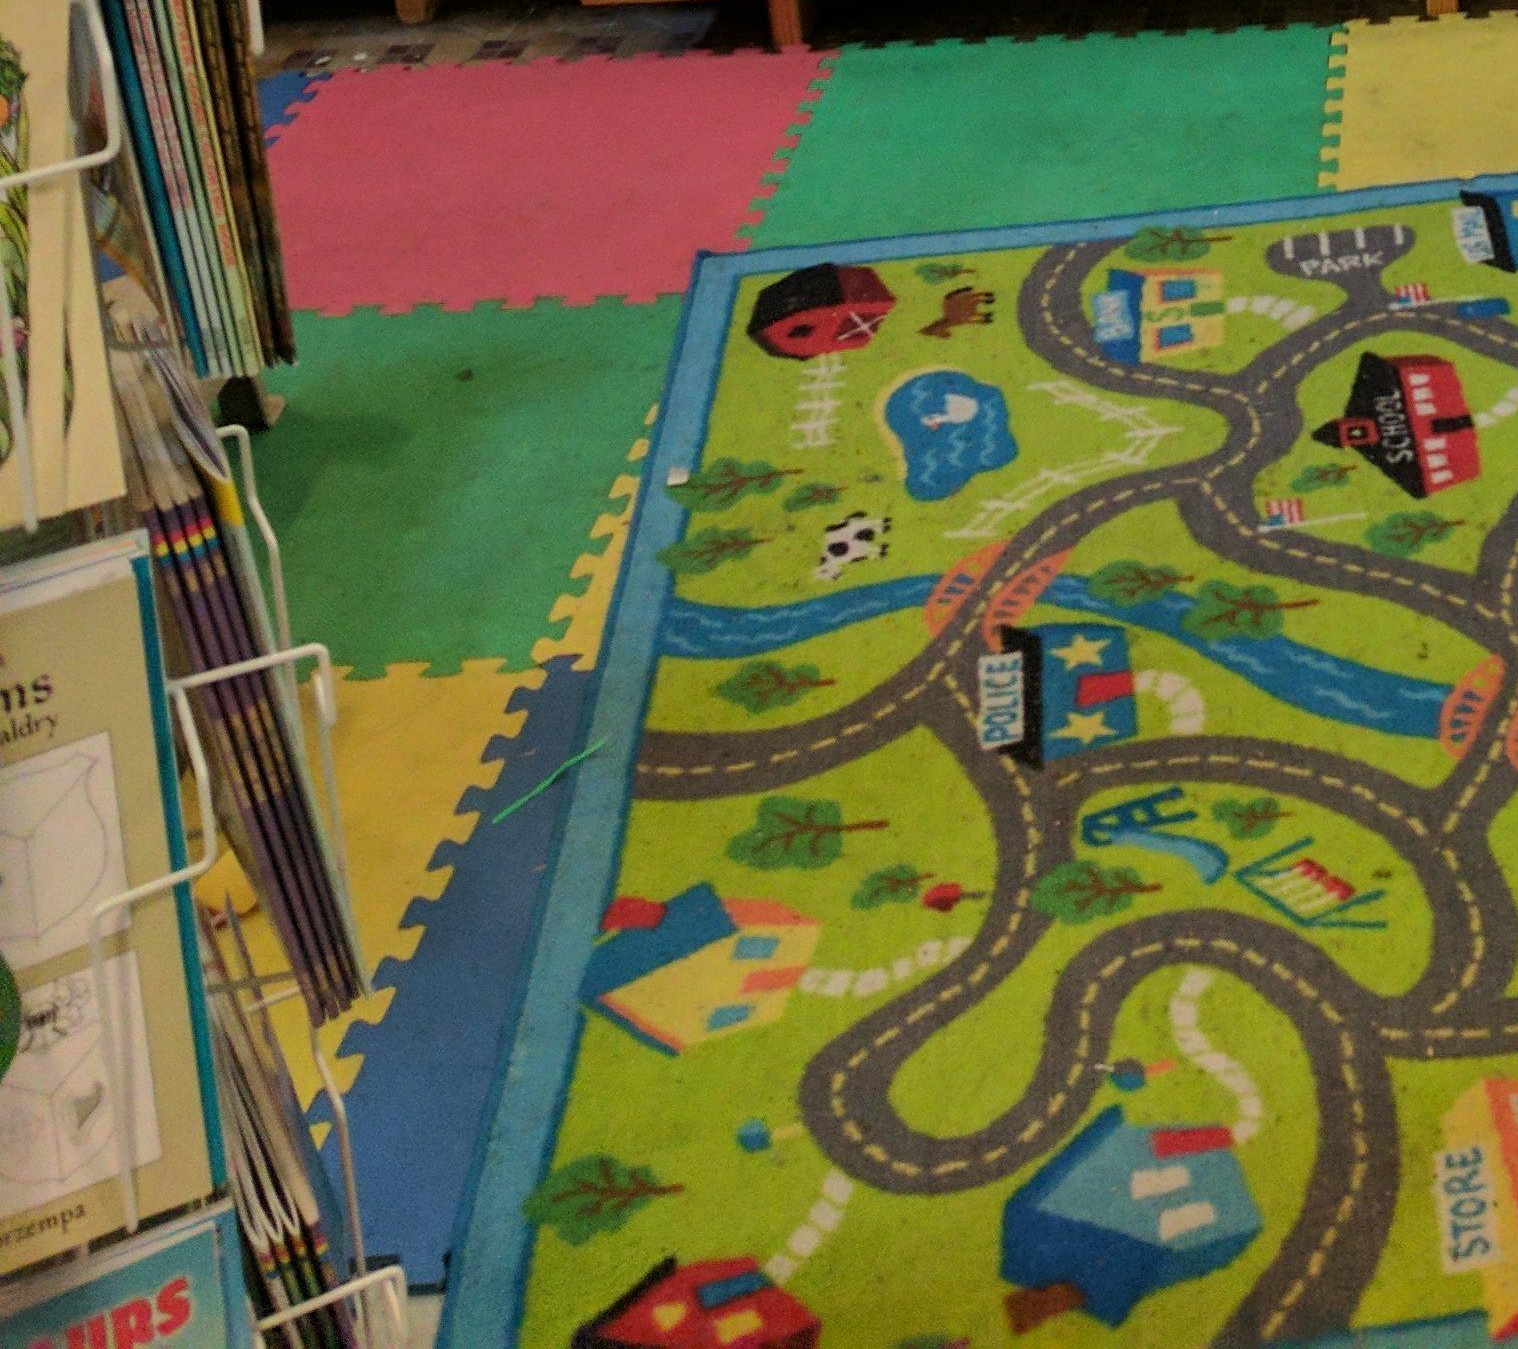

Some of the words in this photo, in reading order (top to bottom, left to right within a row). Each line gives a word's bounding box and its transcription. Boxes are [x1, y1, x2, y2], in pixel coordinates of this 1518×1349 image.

[1299, 248, 1386, 278] PARK
[1385, 386, 1414, 464] SCHOOL
[982, 652, 1023, 750] POLICE
[1446, 1143, 1496, 1267] STORE
